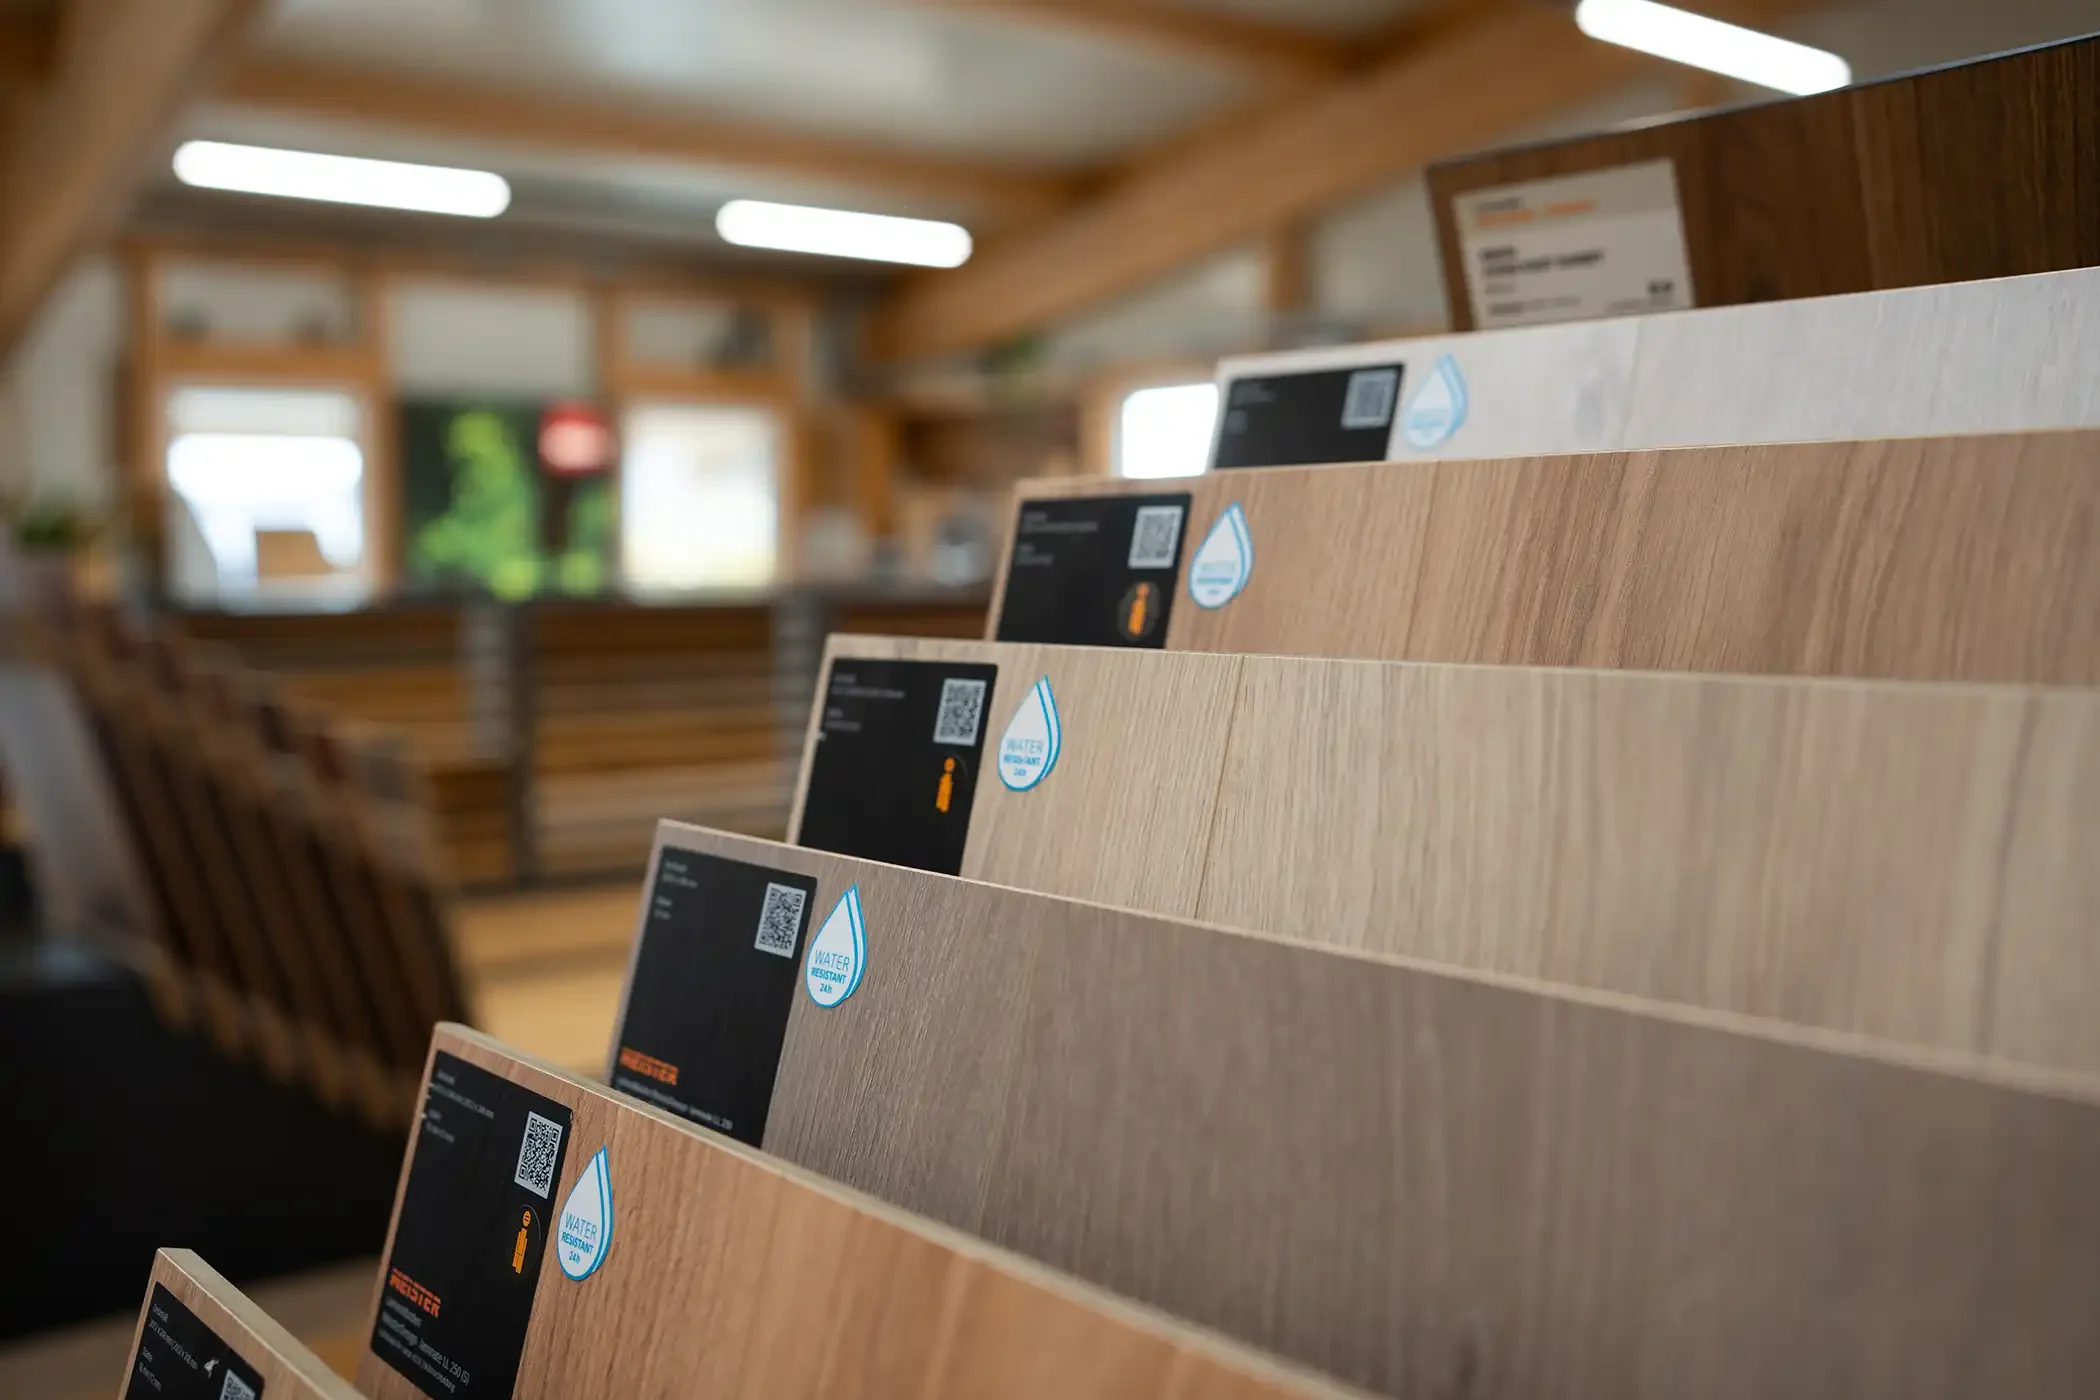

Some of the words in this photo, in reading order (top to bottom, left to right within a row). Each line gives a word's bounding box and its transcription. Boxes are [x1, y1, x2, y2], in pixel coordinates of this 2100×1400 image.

[815, 950, 850, 972] WATER
[811, 967, 847, 985] RESISTANT
[819, 983, 833, 994] 24h
[565, 1211, 598, 1241] WATER
[561, 1231, 594, 1256] RESISTANT
[568, 1250, 580, 1264] 24h
